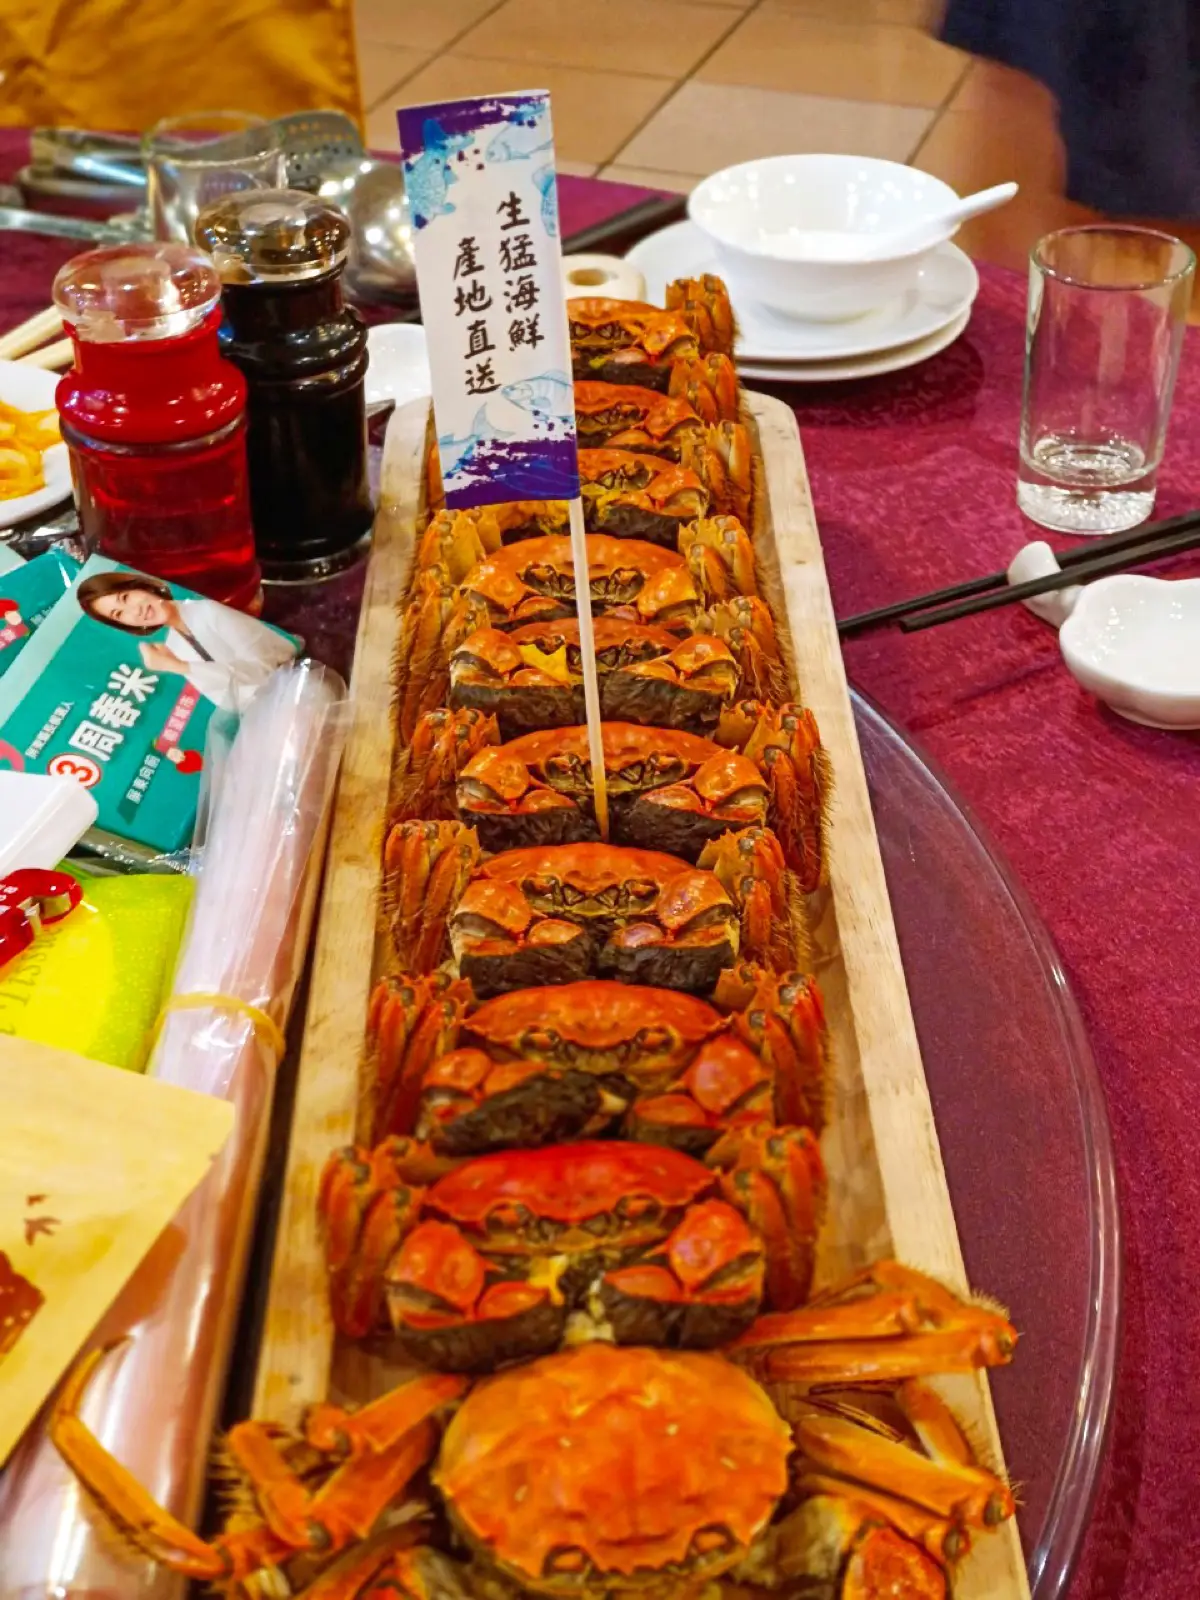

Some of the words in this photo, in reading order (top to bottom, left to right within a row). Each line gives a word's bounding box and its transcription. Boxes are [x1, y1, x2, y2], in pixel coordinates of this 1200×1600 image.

[453, 236, 502, 395] 產地直送
[496, 191, 545, 352] 生猛海鮮
[56, 760, 93, 782] 3
[68, 663, 159, 762] 周春米
